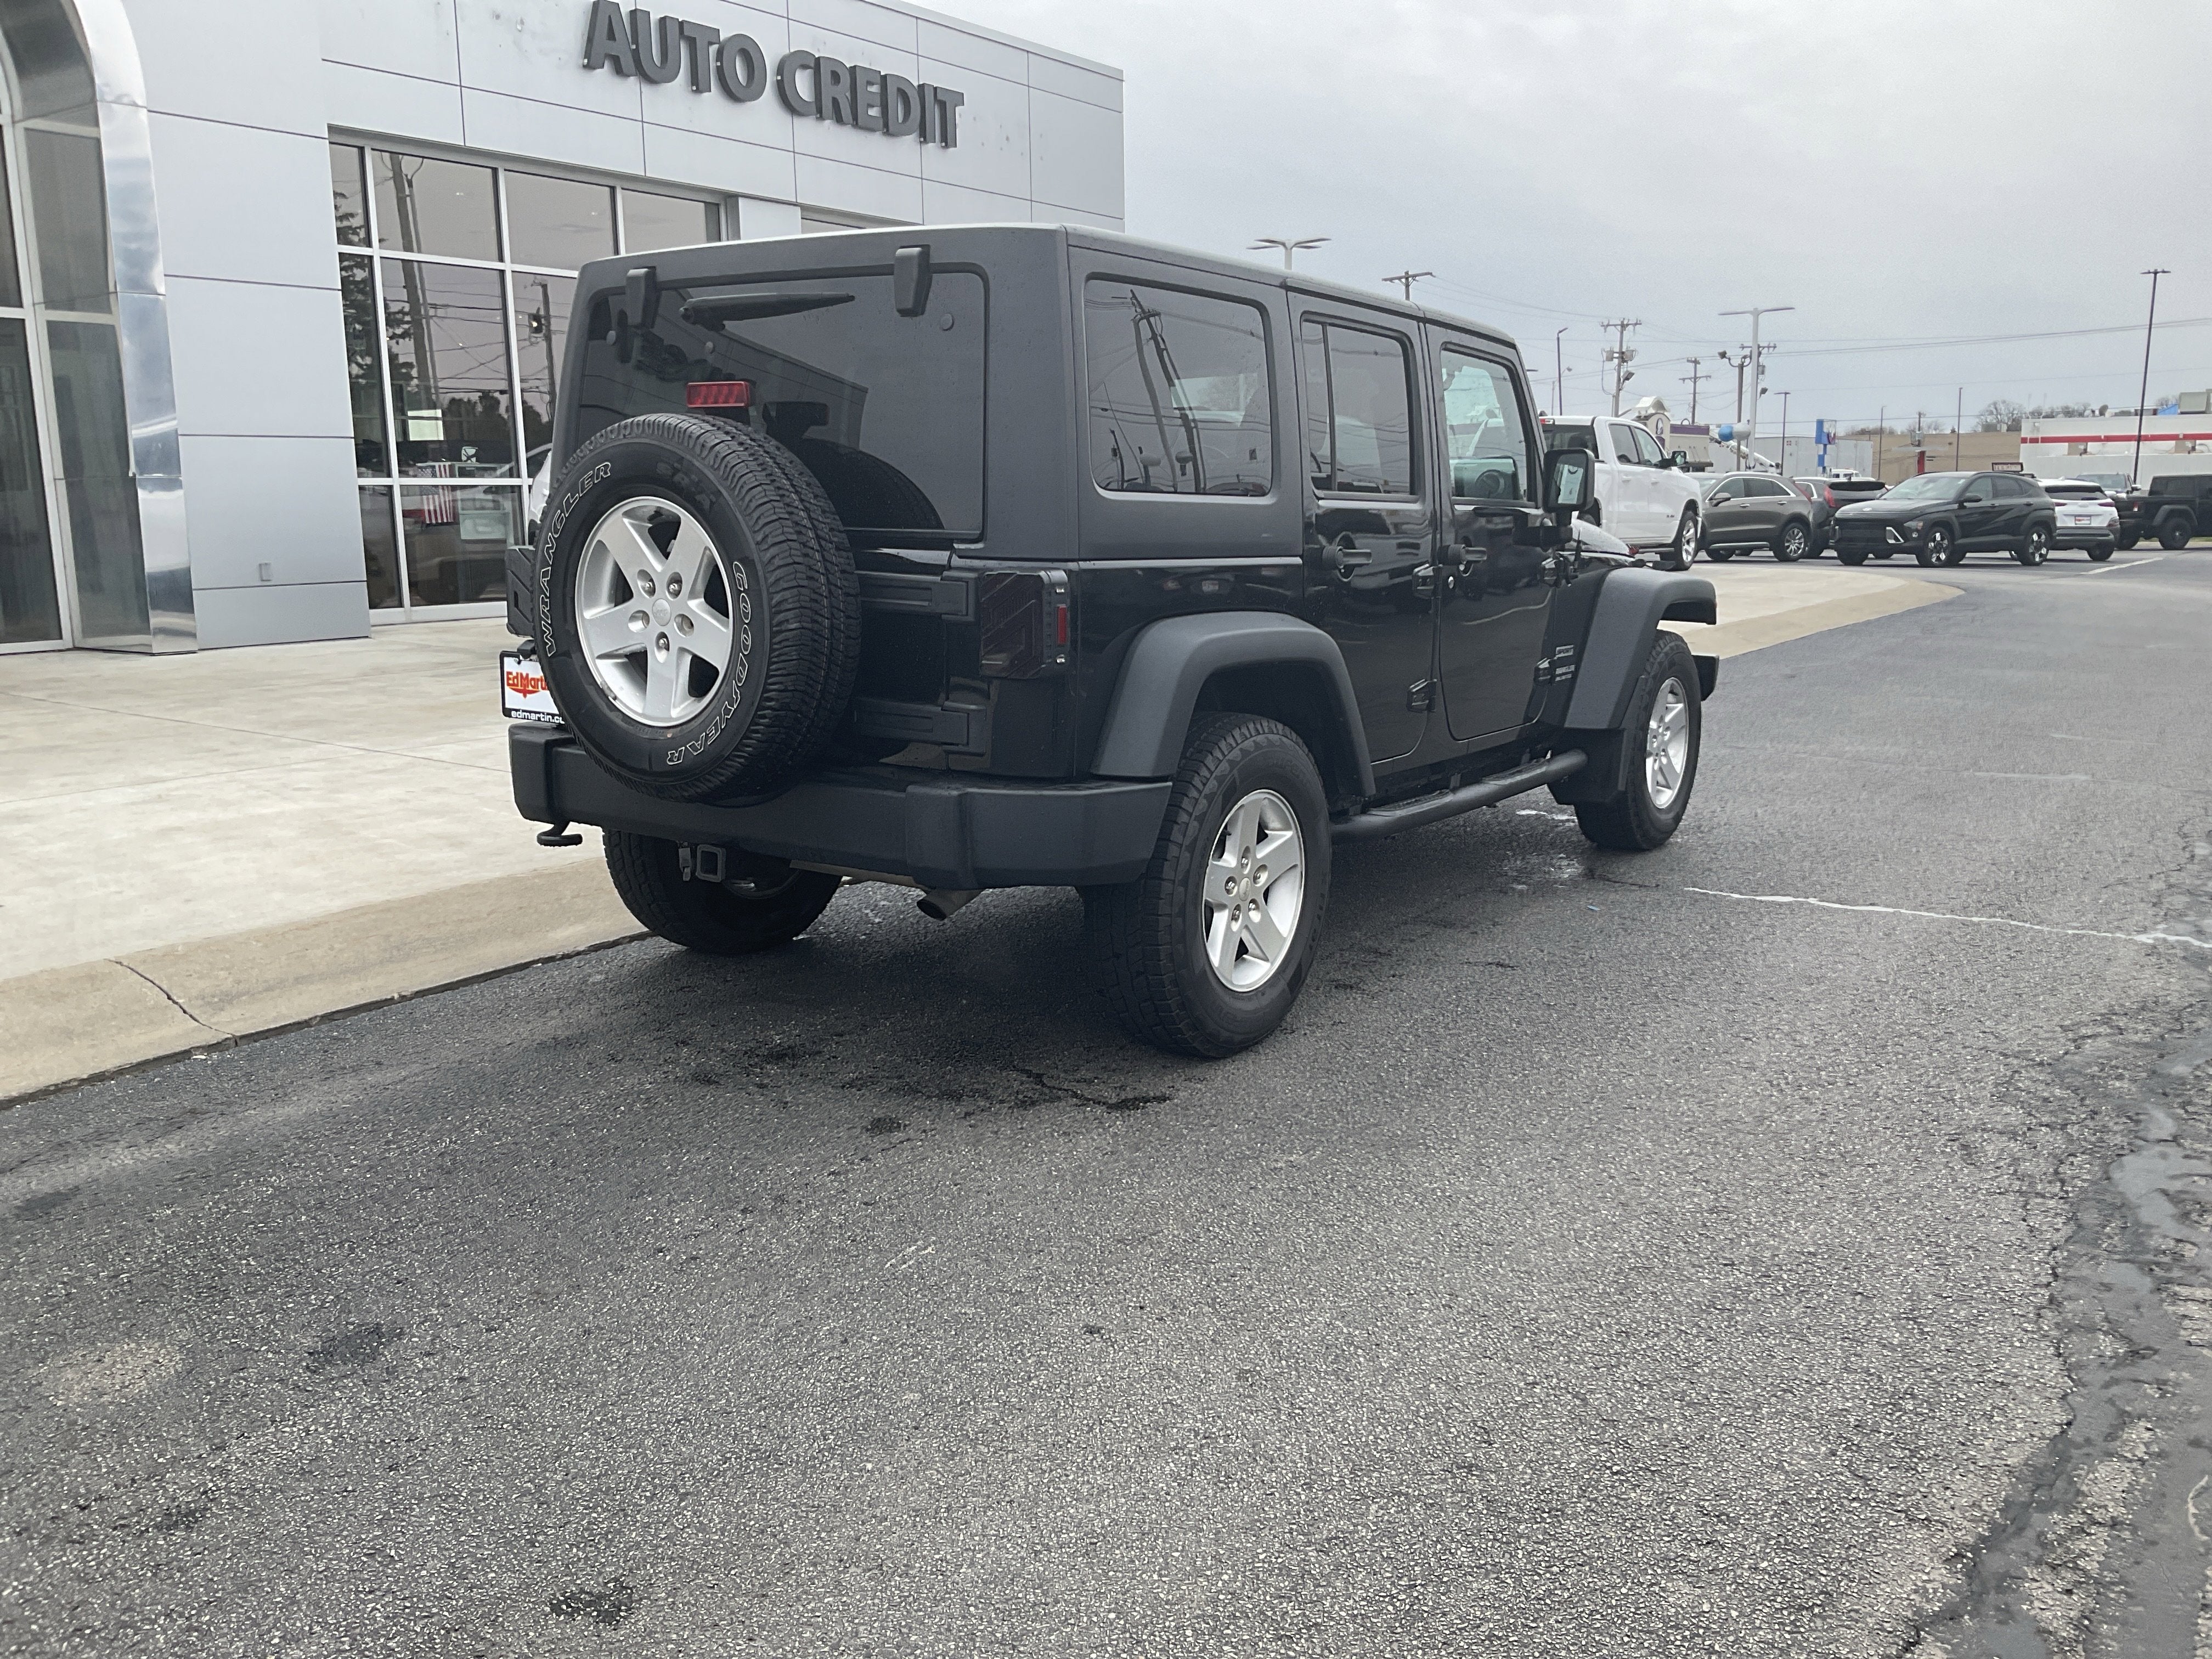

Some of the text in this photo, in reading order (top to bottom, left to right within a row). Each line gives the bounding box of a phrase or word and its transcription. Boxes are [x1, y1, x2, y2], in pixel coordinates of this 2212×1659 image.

[583, 0, 964, 148] AUTO CREDIT
[539, 461, 611, 657] WRANGLER
[511, 709, 565, 724] edmartin.c
[666, 561, 752, 766] GOODYEAR
